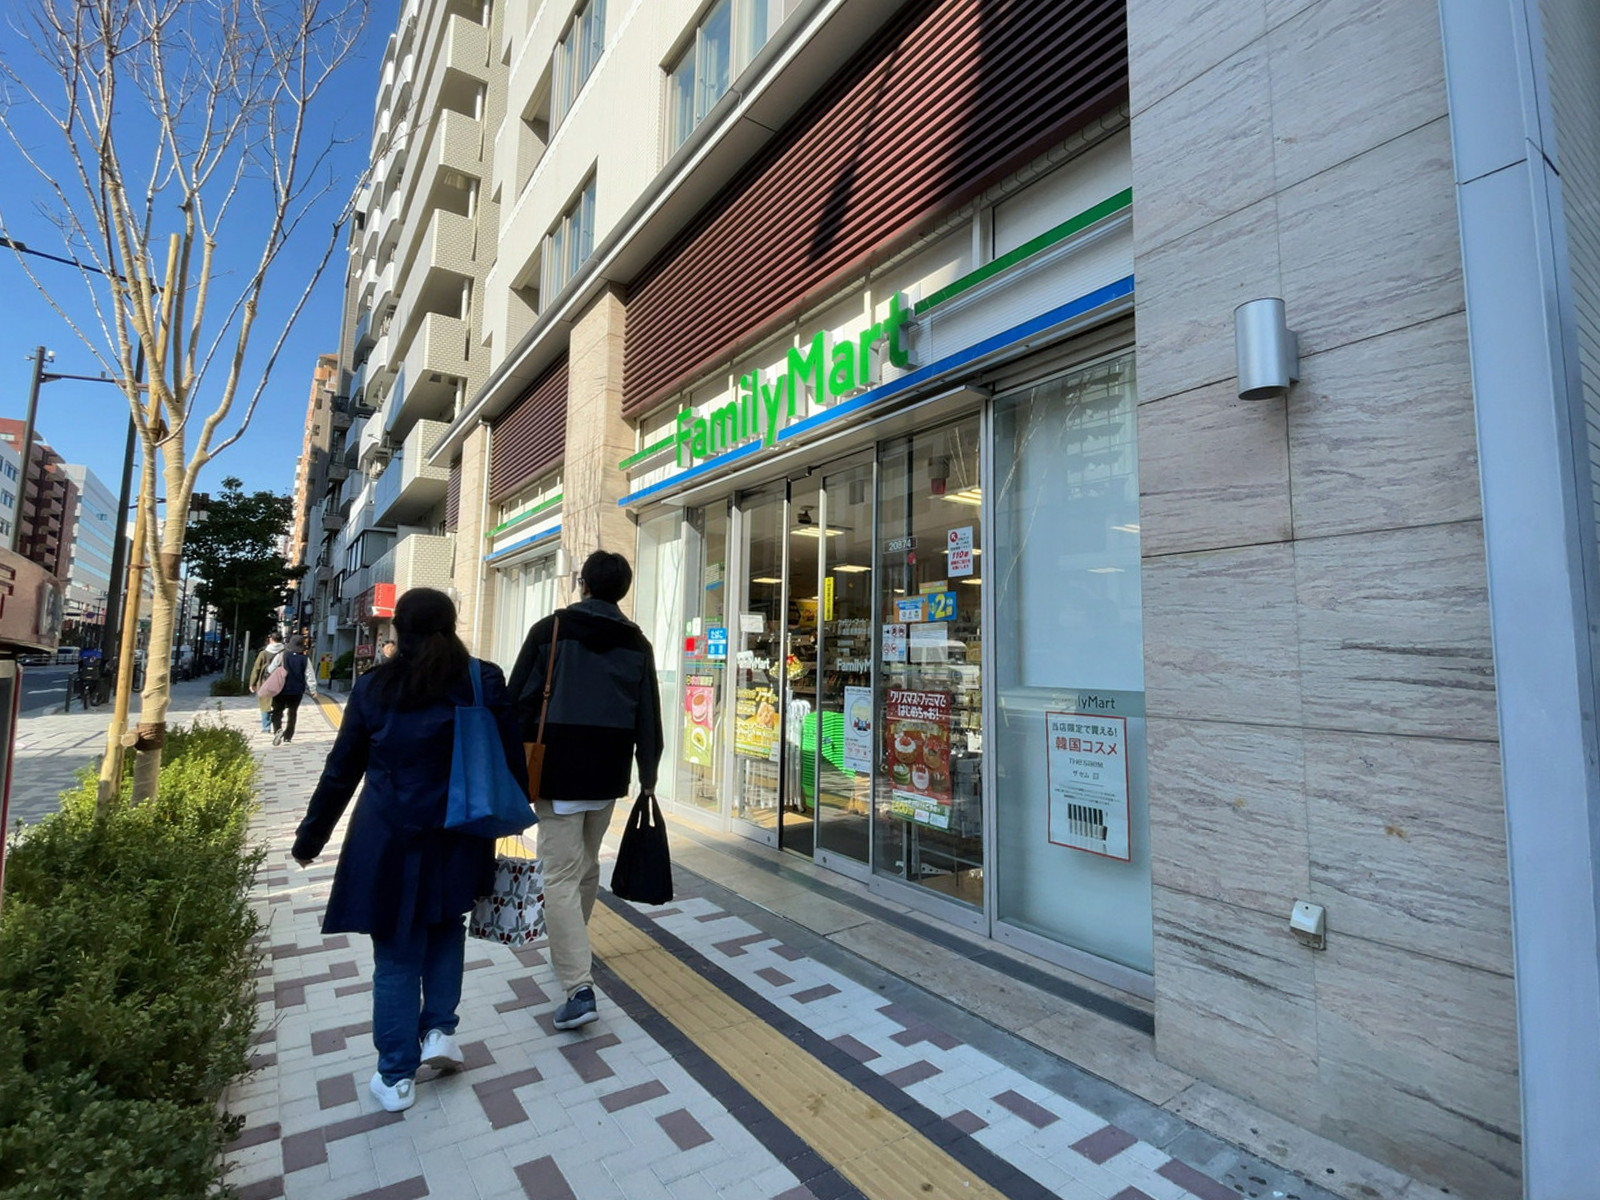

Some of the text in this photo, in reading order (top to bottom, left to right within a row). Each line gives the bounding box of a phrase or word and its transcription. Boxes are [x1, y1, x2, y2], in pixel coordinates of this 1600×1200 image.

[676, 290, 917, 468] FamilyMart
[1055, 735, 1118, 756] 韓国コスメ
